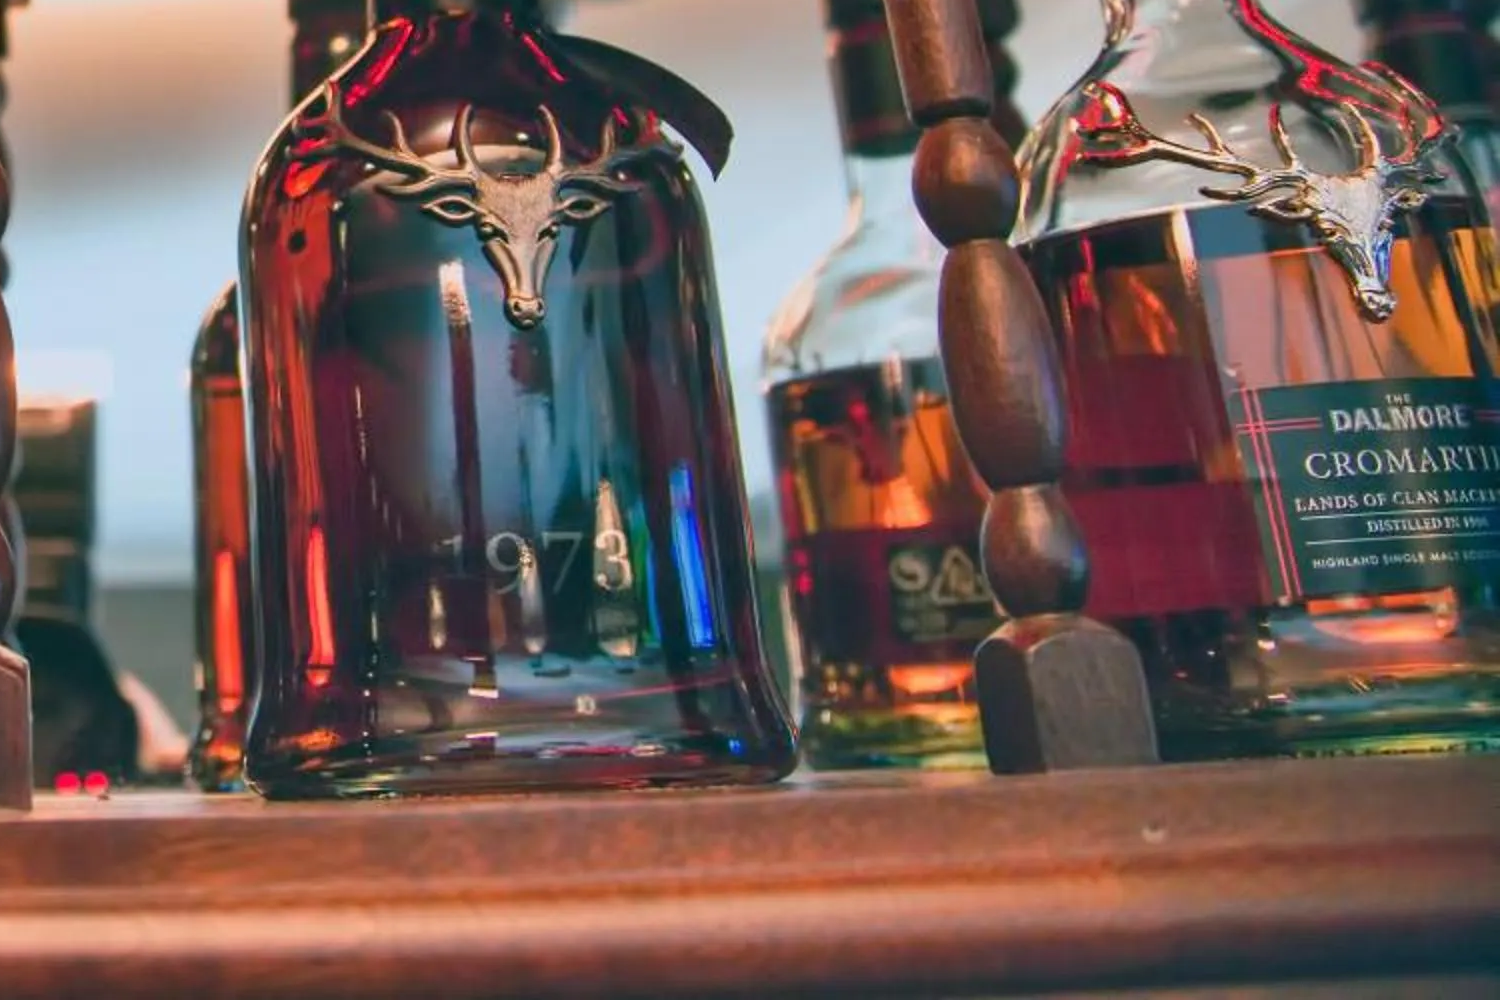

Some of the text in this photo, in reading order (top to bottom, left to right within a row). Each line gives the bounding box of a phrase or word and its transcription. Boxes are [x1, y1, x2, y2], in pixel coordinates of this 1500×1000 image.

[1385, 393, 1412, 404] THE
[1329, 404, 1470, 433] DALMORE
[1295, 494, 1358, 513] LANDS
[1363, 492, 1388, 507] OF
[1393, 489, 1439, 506] CLAN
[1366, 518, 1443, 534] DISTILLED
[434, 529, 633, 595] 1973
[1313, 555, 1379, 569] HIGHLAND
